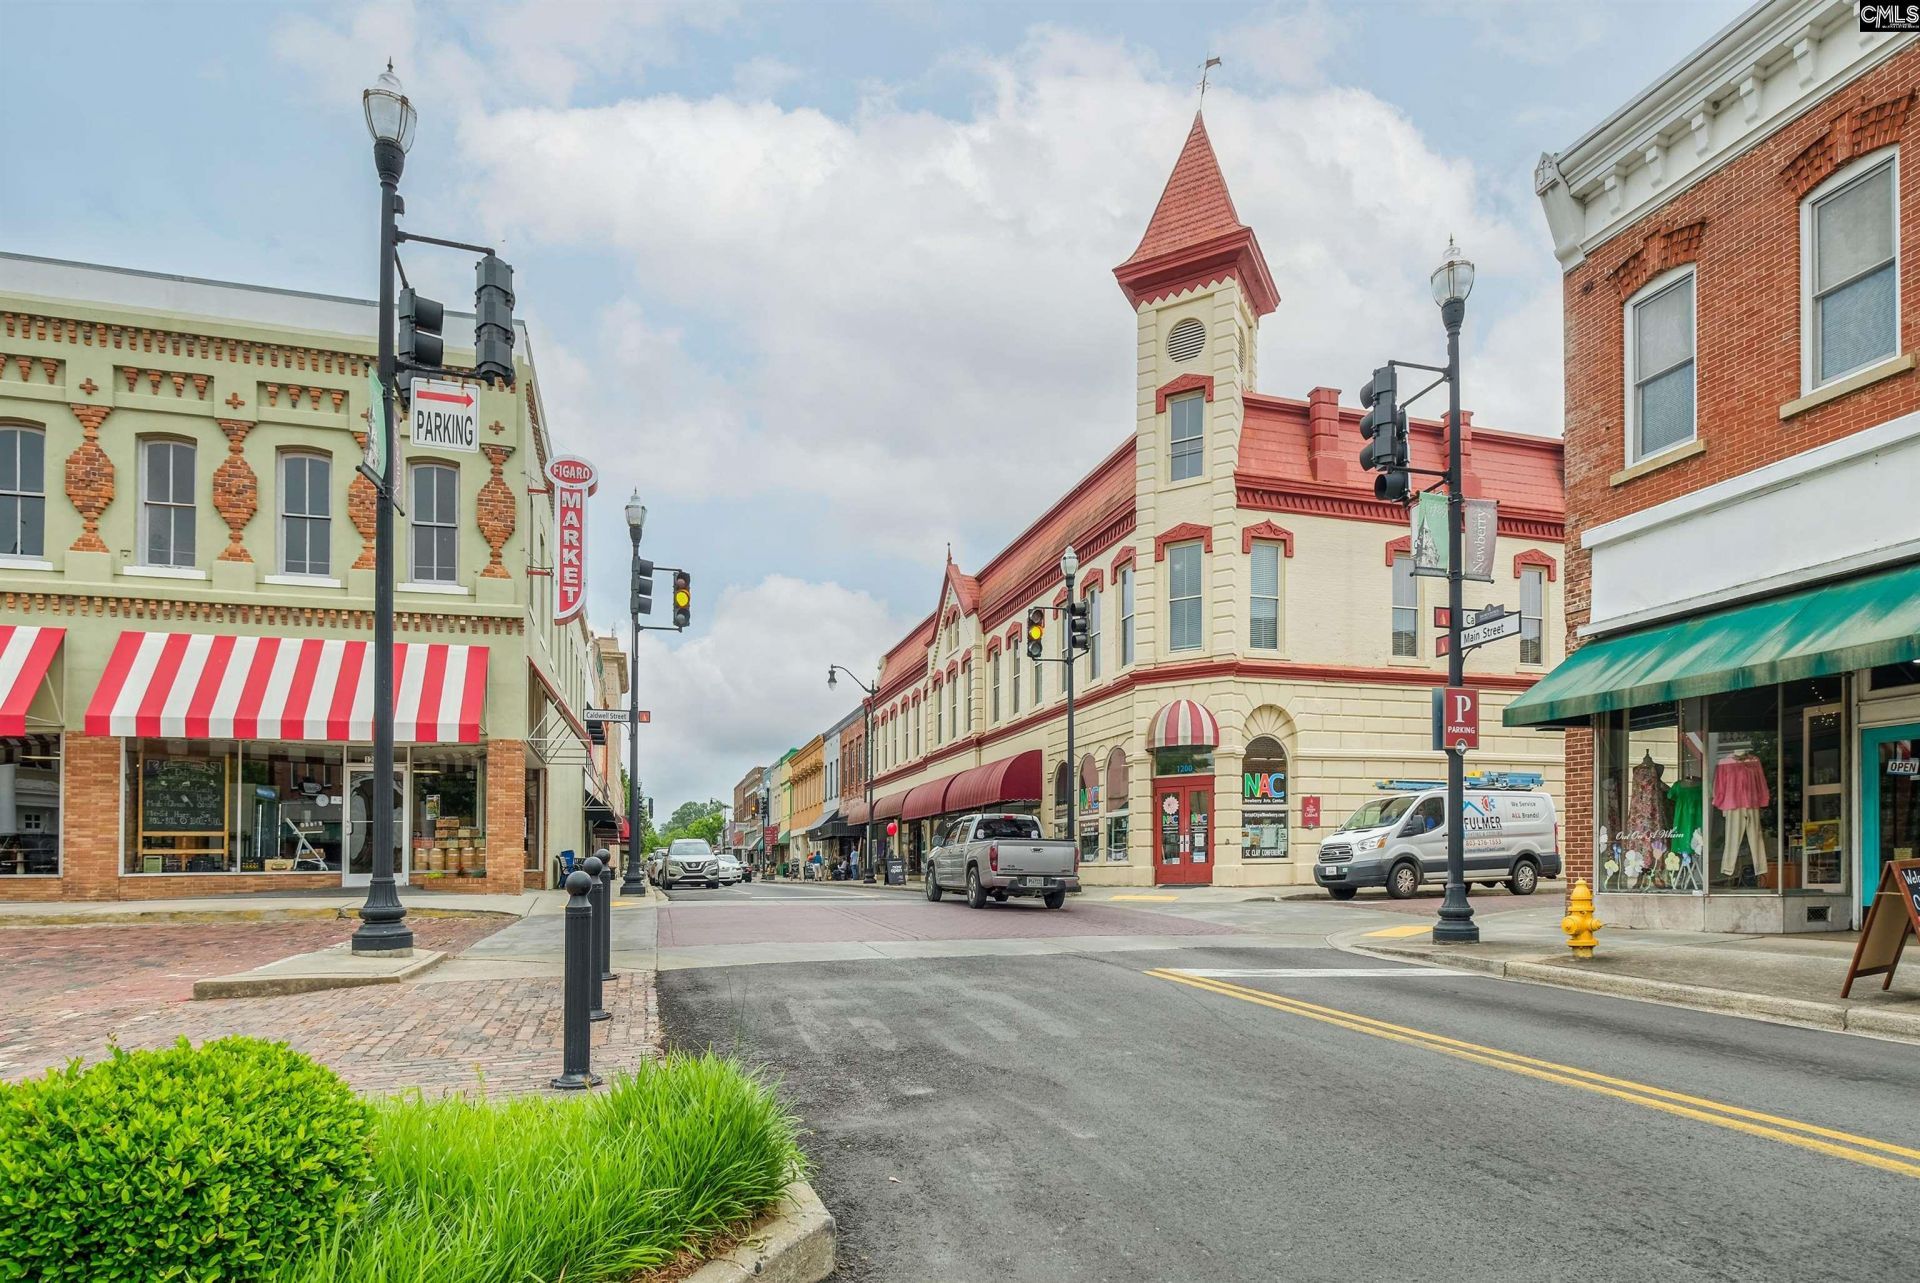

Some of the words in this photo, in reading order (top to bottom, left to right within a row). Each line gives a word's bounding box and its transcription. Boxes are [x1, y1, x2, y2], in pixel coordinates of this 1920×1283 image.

[417, 410, 473, 446] PARKING
[553, 464, 590, 480] FIGARO
[562, 491, 581, 603] MARKET
[1472, 510, 1490, 572] Newberry
[1463, 631, 1480, 644] Main
[1482, 624, 1504, 639] Street
[586, 711, 609, 719] Caldwell
[1454, 695, 1471, 723] P
[1447, 726, 1476, 734] PARKING
[1177, 765, 1193, 773] 1200
[1890, 762, 1917, 772] OPEN
[1244, 773, 1285, 798] NAC
[1464, 816, 1502, 830] FULMER
[1615, 831, 1629, 840] Out
[1631, 831, 1643, 839] On
[1660, 827, 1684, 838] Whim
[1245, 849, 1251, 857] SC
[1261, 849, 1285, 857] CONFERENCE
